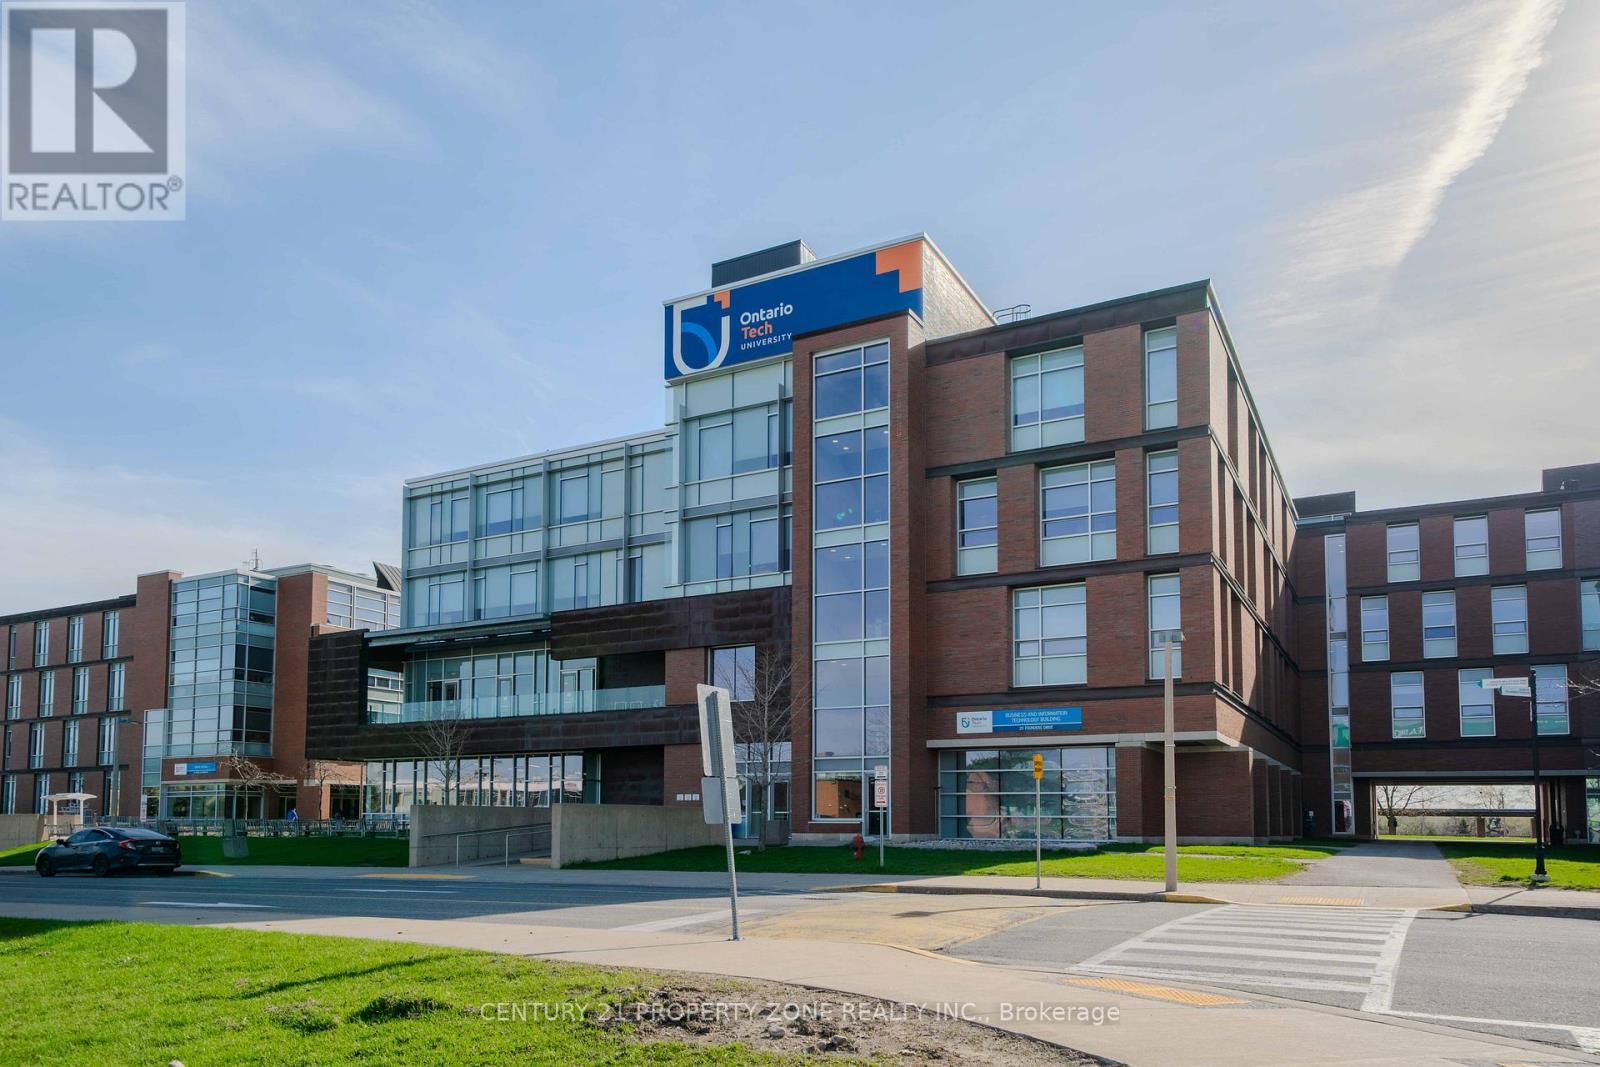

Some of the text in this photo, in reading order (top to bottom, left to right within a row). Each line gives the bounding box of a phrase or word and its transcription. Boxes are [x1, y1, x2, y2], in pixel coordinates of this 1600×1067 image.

[740, 302, 793, 325] Ontario
[741, 320, 773, 339] Tech
[740, 332, 792, 350] UNIVERSITY
